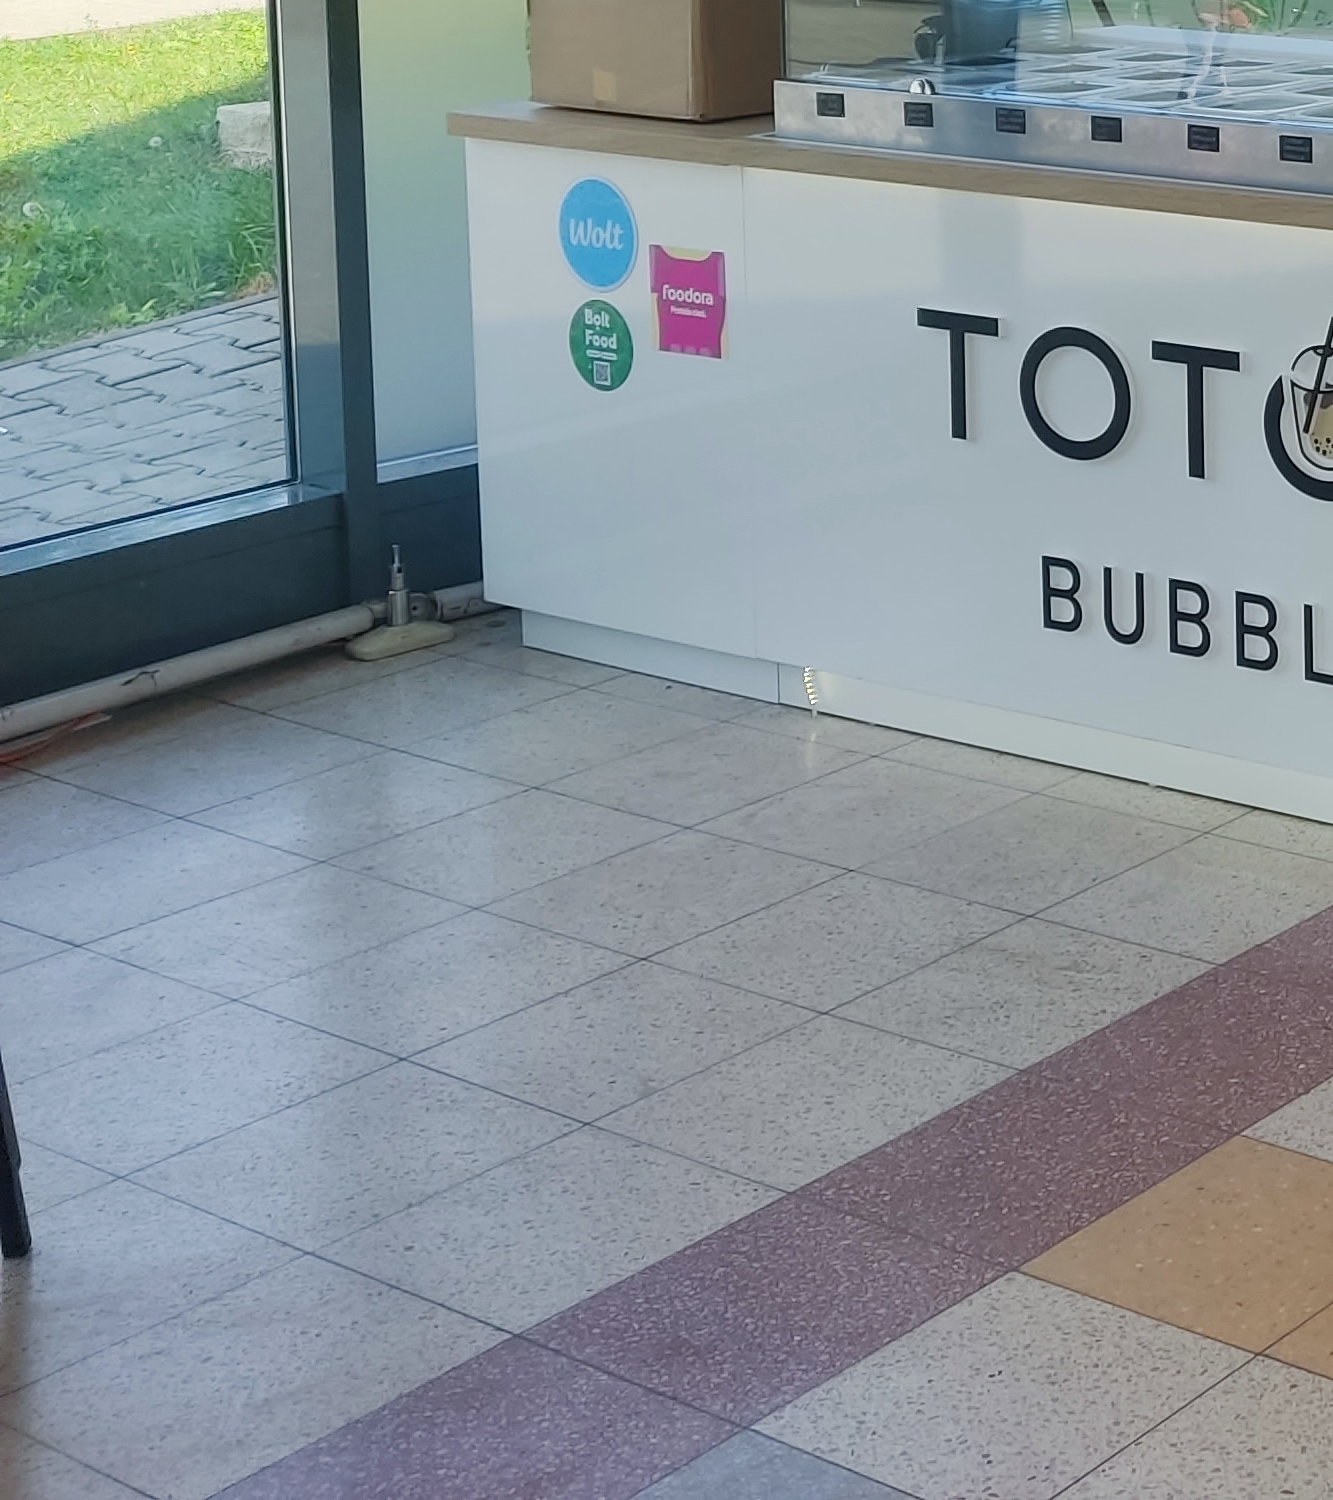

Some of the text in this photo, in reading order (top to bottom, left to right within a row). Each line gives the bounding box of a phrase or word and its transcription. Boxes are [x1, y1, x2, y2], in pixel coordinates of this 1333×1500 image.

[569, 217, 624, 250] Wolt
[662, 284, 714, 306] foodora
[584, 307, 610, 329] Bolt
[585, 329, 617, 350] Food
